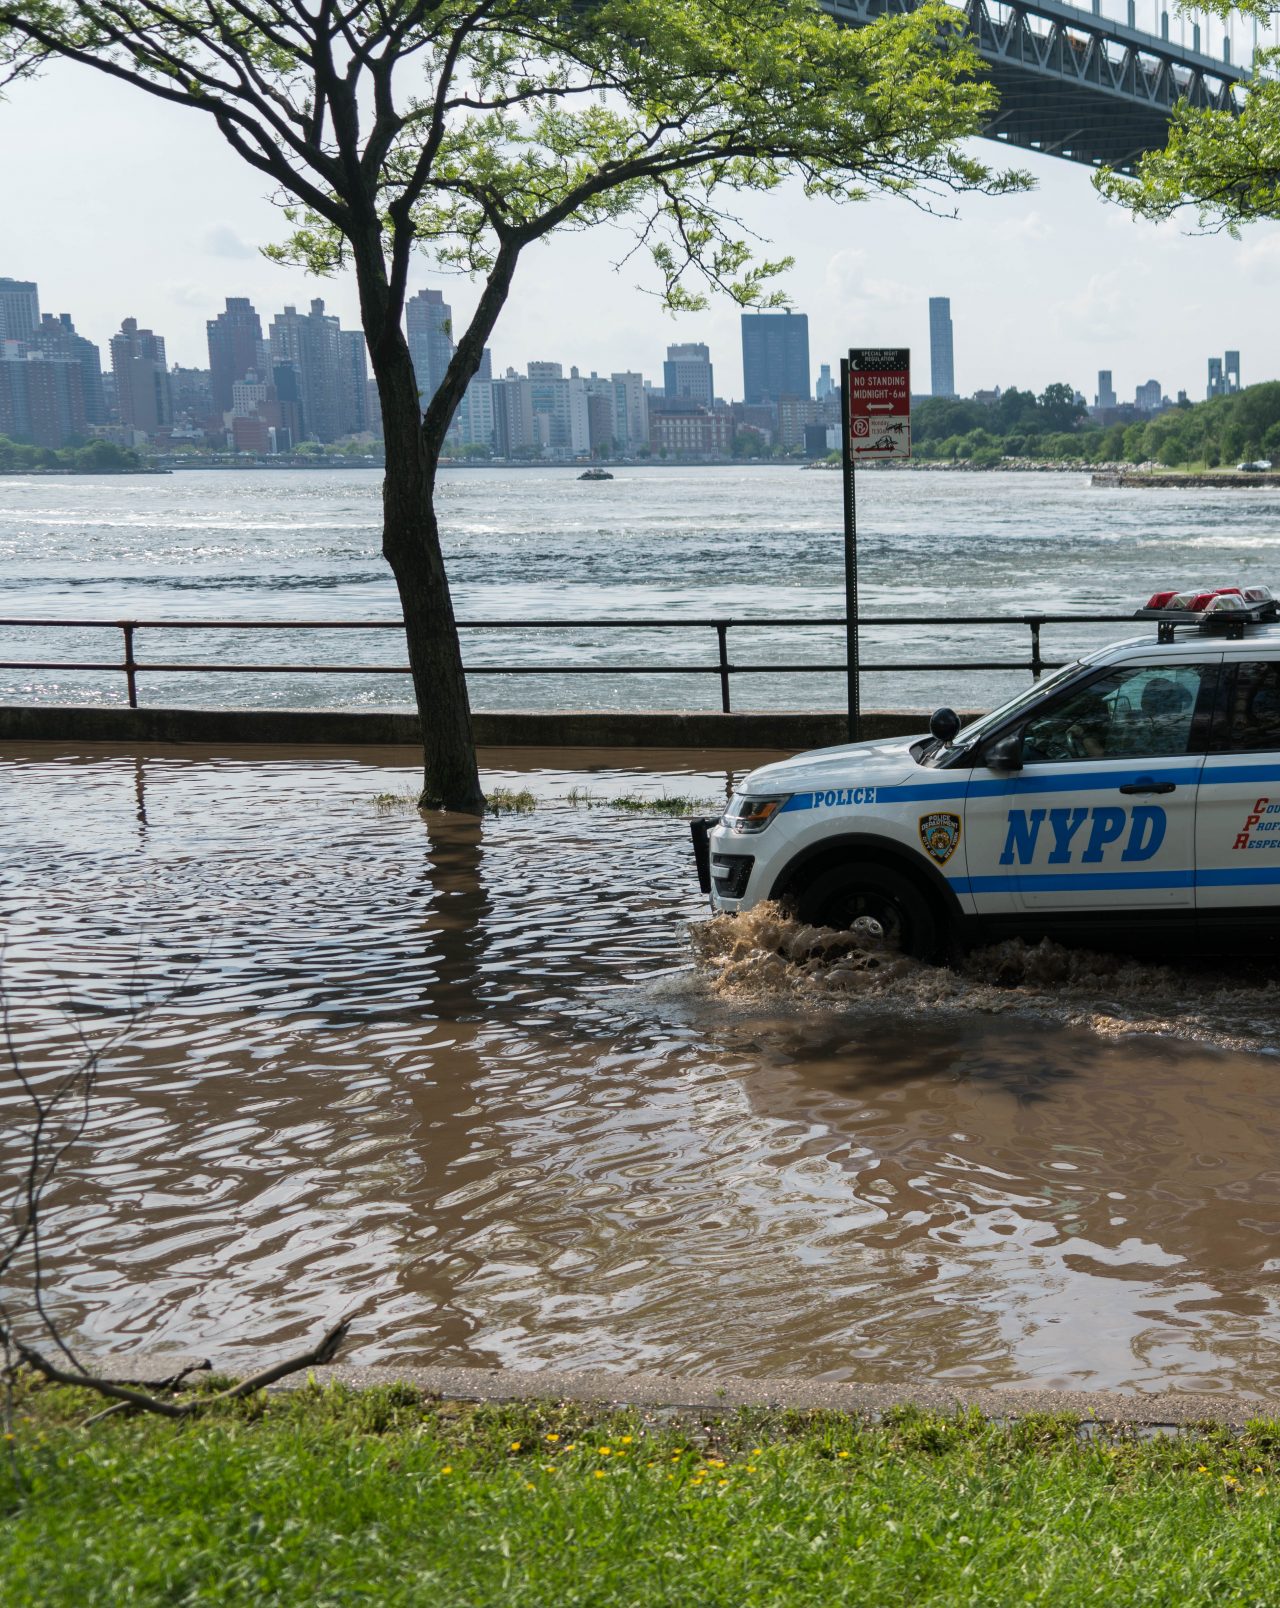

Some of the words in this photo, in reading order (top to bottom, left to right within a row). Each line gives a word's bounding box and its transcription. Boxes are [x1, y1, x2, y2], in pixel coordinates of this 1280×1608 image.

[854, 377, 865, 386] NO
[868, 376, 905, 386] STANDING
[814, 787, 875, 808] POLICE
[921, 820, 958, 831] DEPARTMENT
[998, 805, 1167, 865] NYPD
